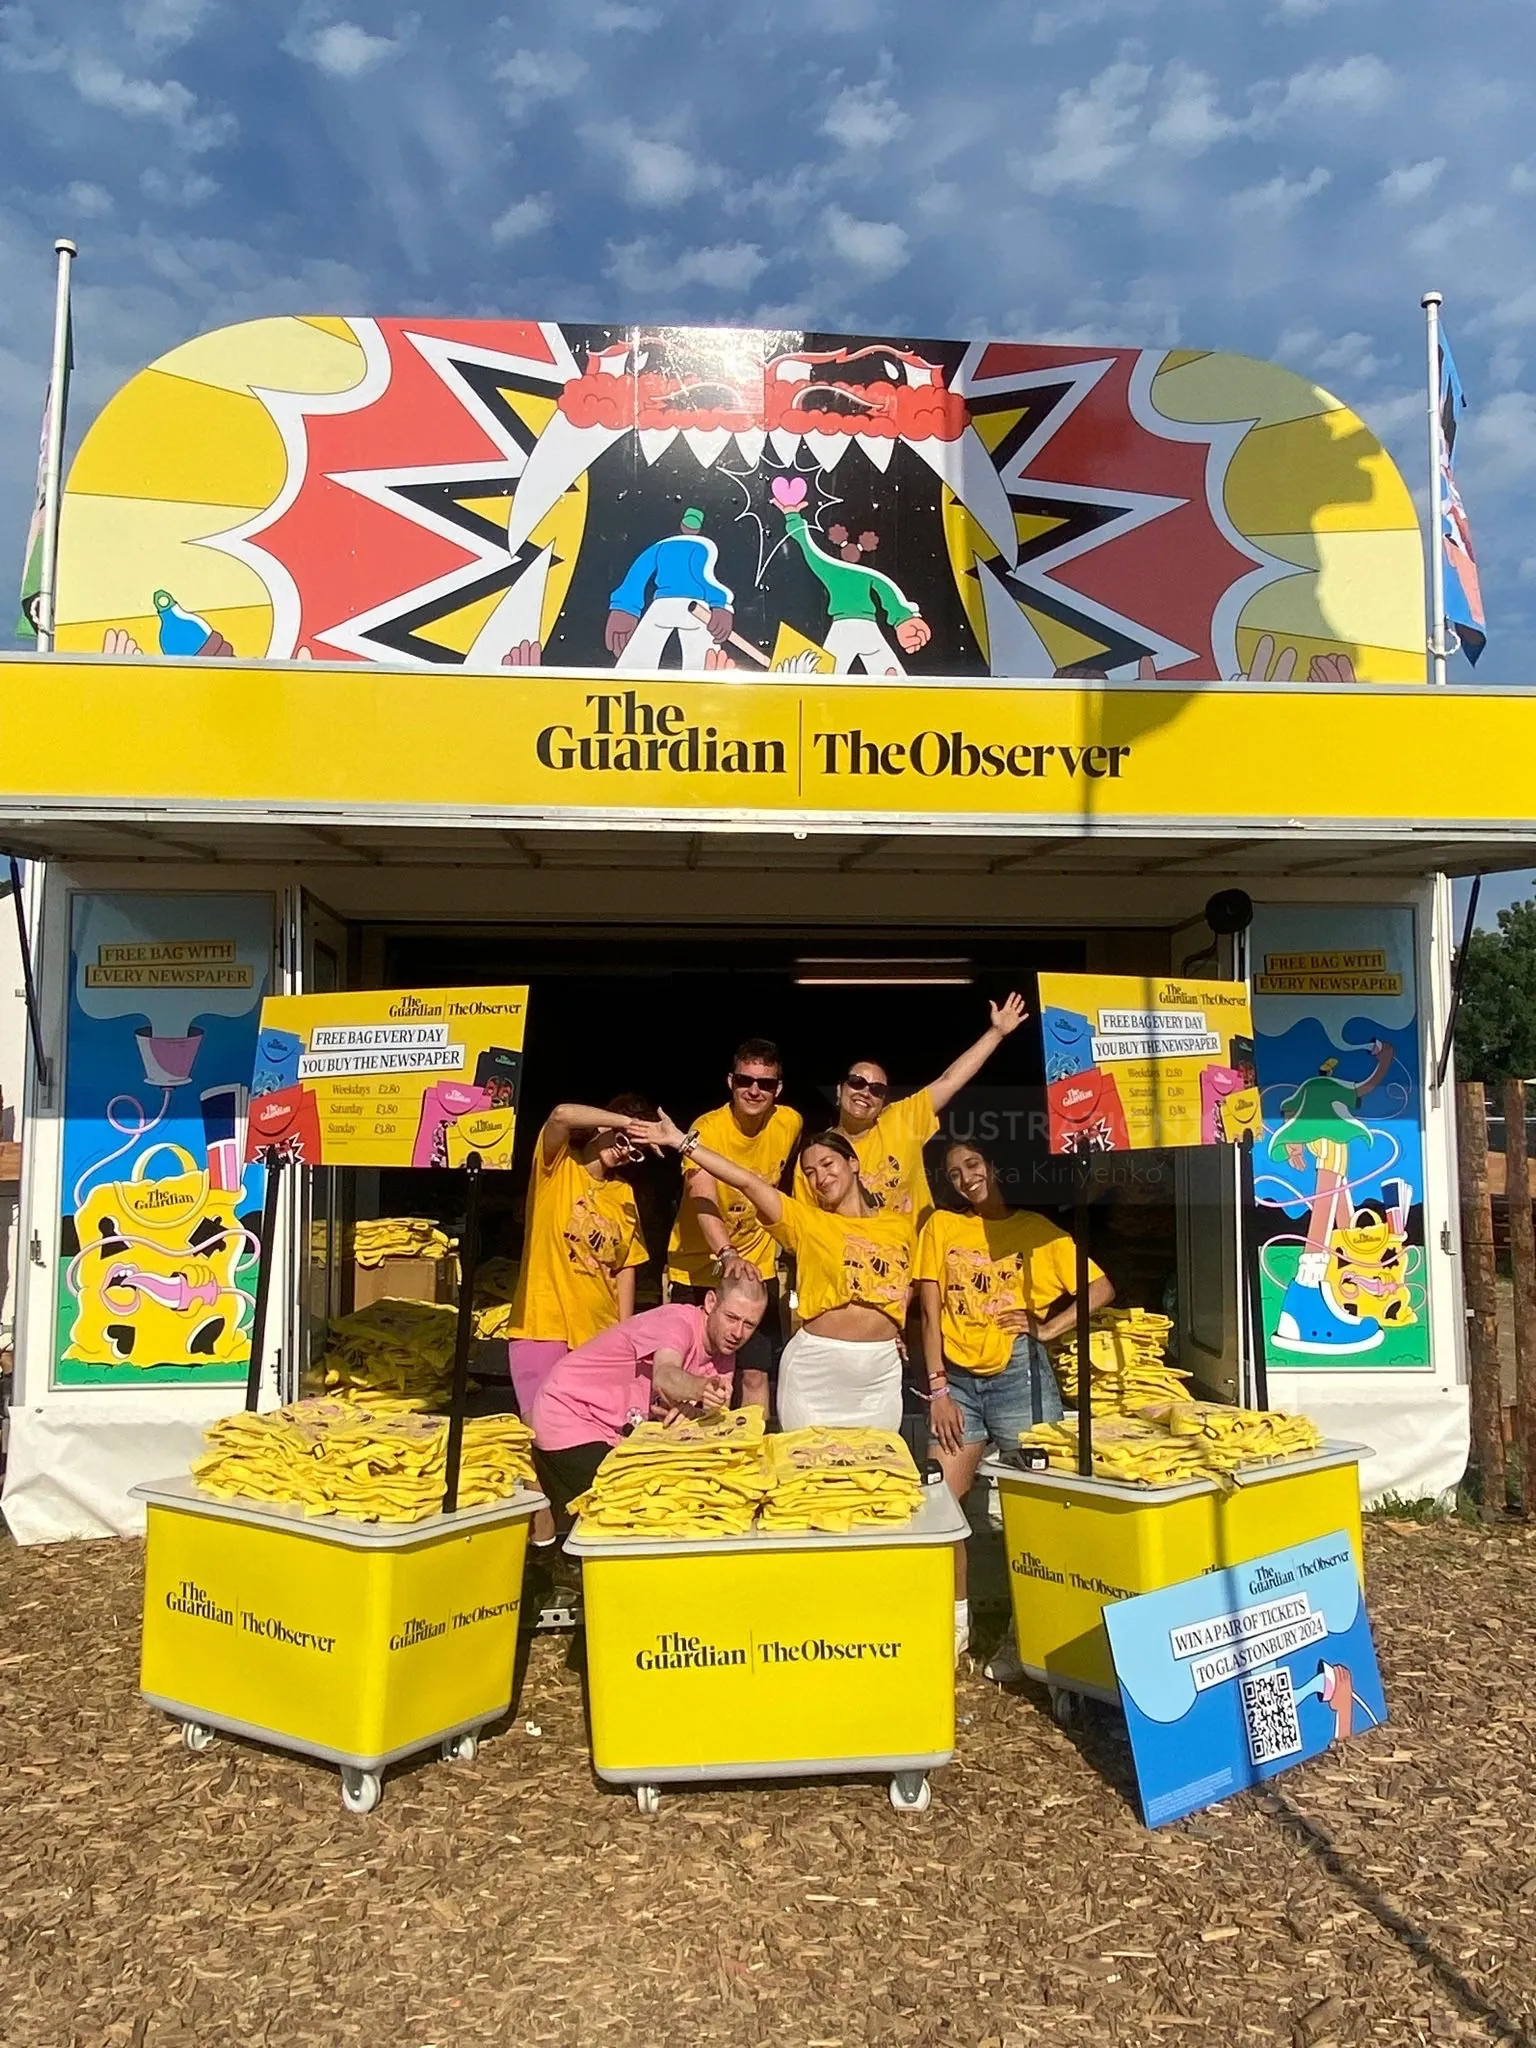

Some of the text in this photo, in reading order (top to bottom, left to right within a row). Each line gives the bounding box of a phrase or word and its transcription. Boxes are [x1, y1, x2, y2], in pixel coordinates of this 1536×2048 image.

[586, 690, 685, 737] The
[536, 725, 788, 773] Guardian
[104, 944, 232, 961] FREE BAG WITH
[1270, 954, 1382, 970] FREE BAG WITH
[92, 969, 247, 983] EVERY NEWSPAPER
[1260, 977, 1398, 991] EVERY NEWSPAPER
[1159, 991, 1198, 1004] Guardian
[1166, 983, 1182, 995] The
[400, 995, 422, 1008] The
[389, 1003, 442, 1018] Guardian
[1102, 1014, 1203, 1029] FREE BAG EVERY DAY
[316, 1028, 444, 1046] FREE BAG EVERY DAY
[1095, 1037, 1218, 1057] YOU BUY THE NEWSPAPER
[303, 1050, 460, 1073] YOU BUY THE NEWSPAPER
[332, 1084, 400, 1096] Weekdays £2.80
[330, 1104, 398, 1116] Saturday £3.80
[328, 1122, 396, 1135] Sunday £3.80
[134, 1194, 194, 1209] Guardian
[147, 1189, 169, 1202] The
[1019, 1552, 1041, 1567] The
[1011, 1559, 1065, 1585] Guardian
[1255, 1565, 1275, 1581] The
[180, 1580, 207, 1603] The
[1249, 1570, 1295, 1596] Guardian
[166, 1591, 233, 1626] Guardian
[404, 1617, 426, 1635] The
[1175, 1599, 1306, 1652] WIN A PAIR OF TICKETS
[389, 1622, 446, 1651] Guardian
[656, 1631, 700, 1653] The
[635, 1645, 747, 1671] Guardian
[1196, 1618, 1324, 1684] TO GLASTONBURY 2024
